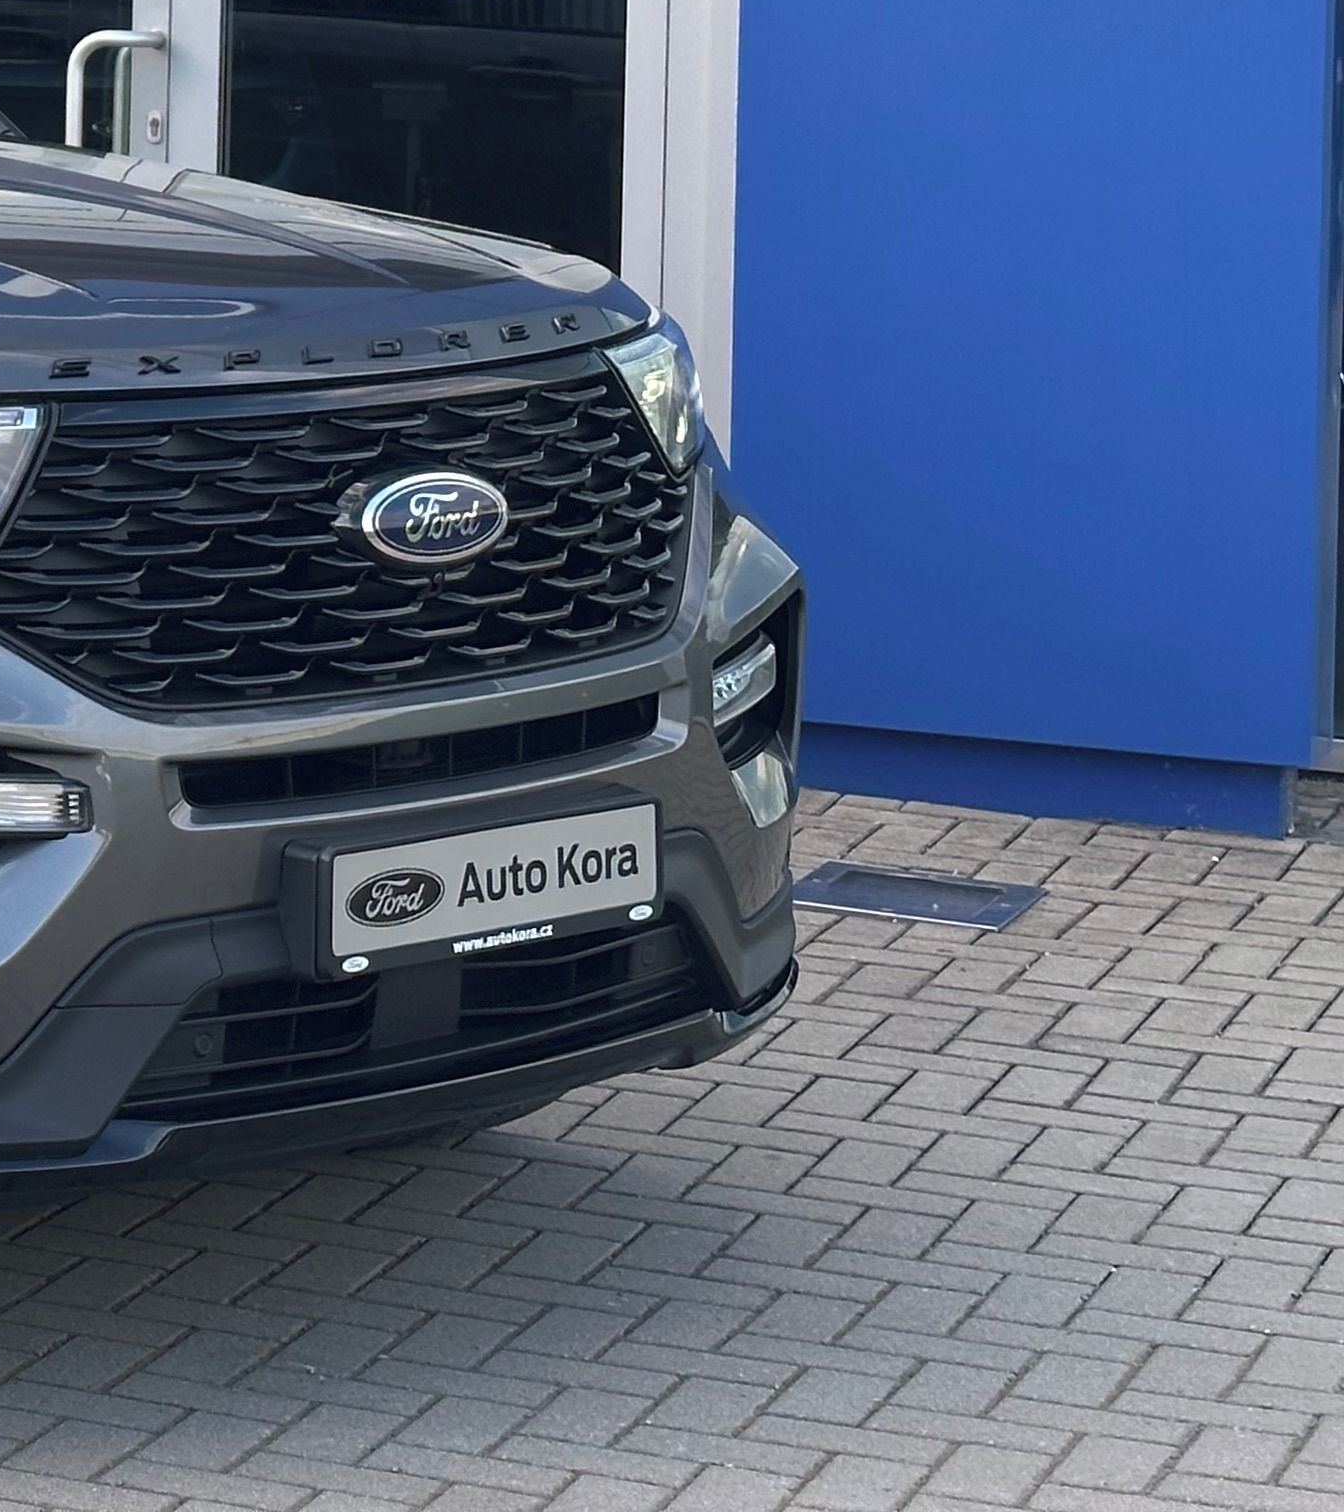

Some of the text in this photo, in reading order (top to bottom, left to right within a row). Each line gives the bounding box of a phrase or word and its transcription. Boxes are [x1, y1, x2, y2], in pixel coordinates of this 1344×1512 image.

[50, 312, 581, 380] EXPLORER
[405, 492, 479, 542] Ford
[365, 843, 640, 919] Ford Auto Kora
[452, 924, 553, 954] www.autokora.cz
